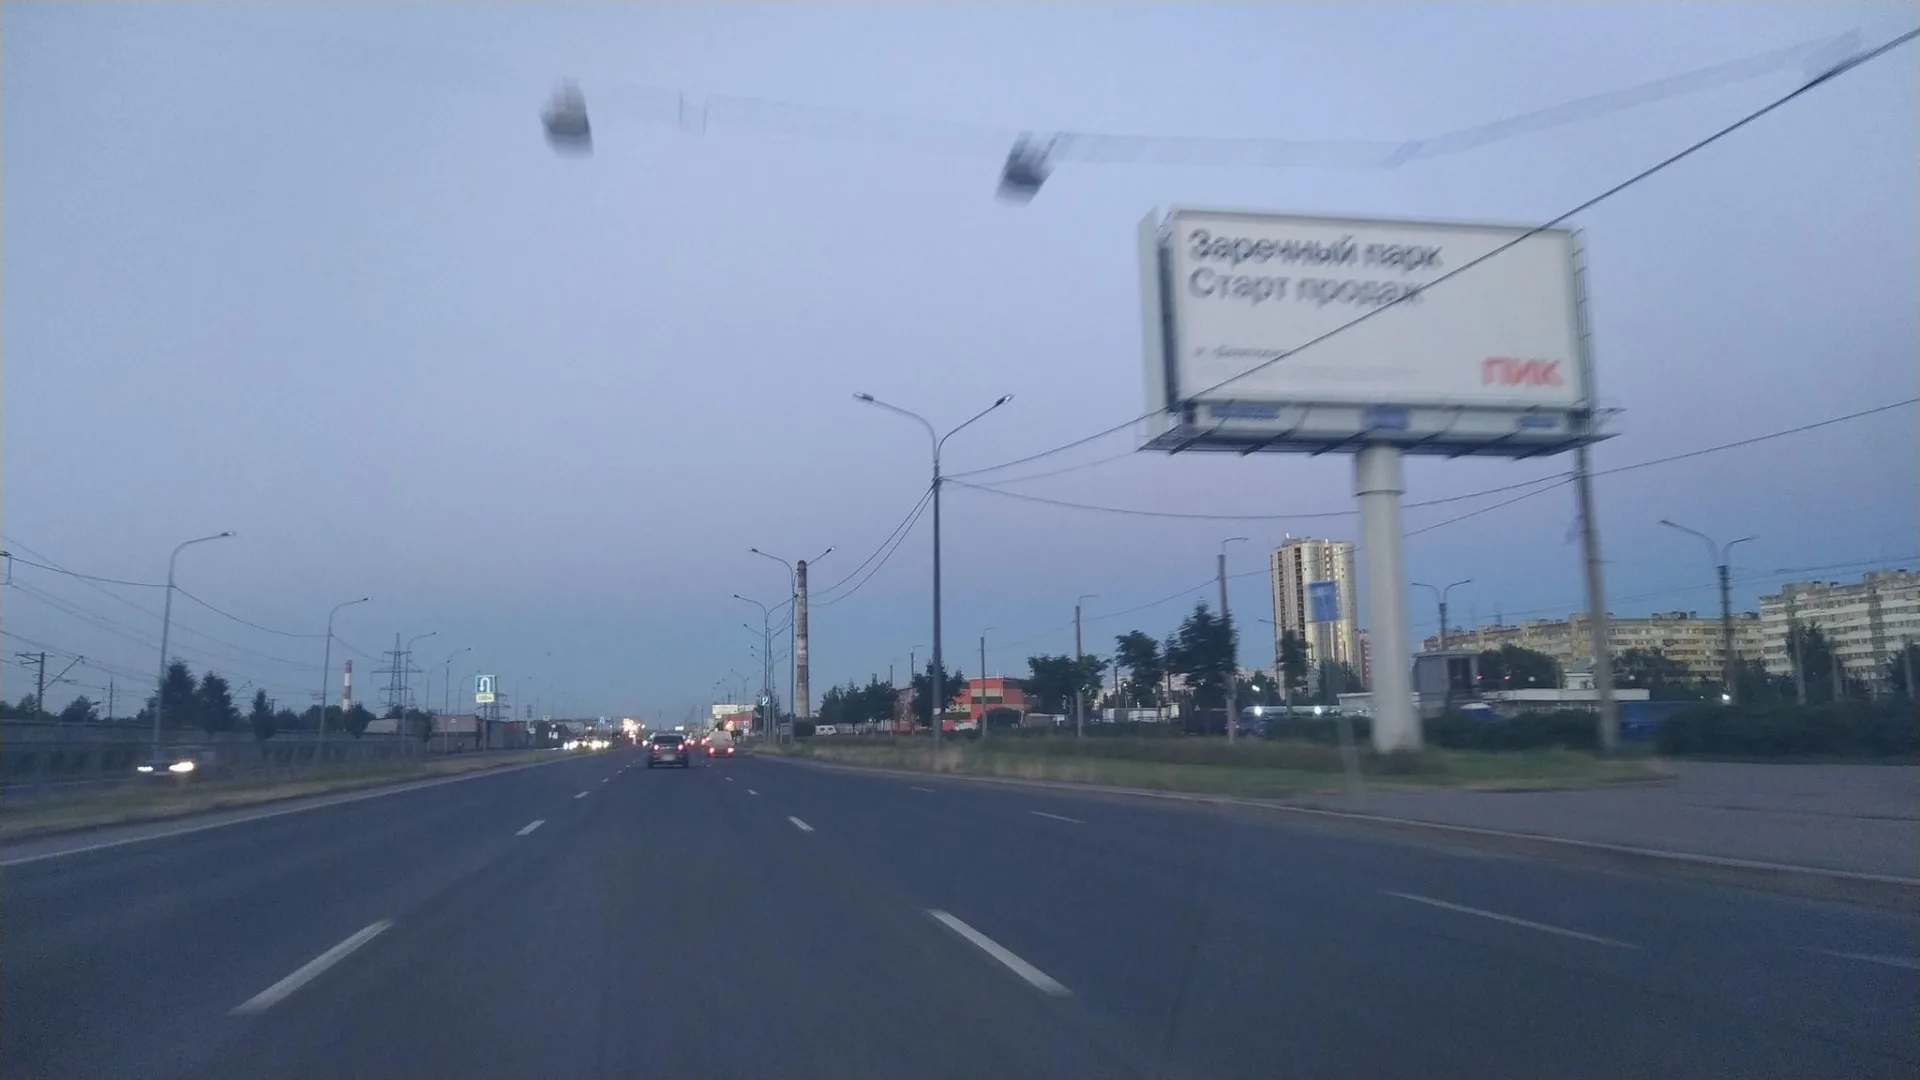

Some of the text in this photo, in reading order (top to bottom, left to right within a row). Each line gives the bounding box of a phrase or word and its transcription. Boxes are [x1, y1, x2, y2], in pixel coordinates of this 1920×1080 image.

[1189, 228, 1443, 274] Заречный парк
[1189, 267, 1425, 308] Старт продаж
[1482, 356, 1564, 386] ПИК
